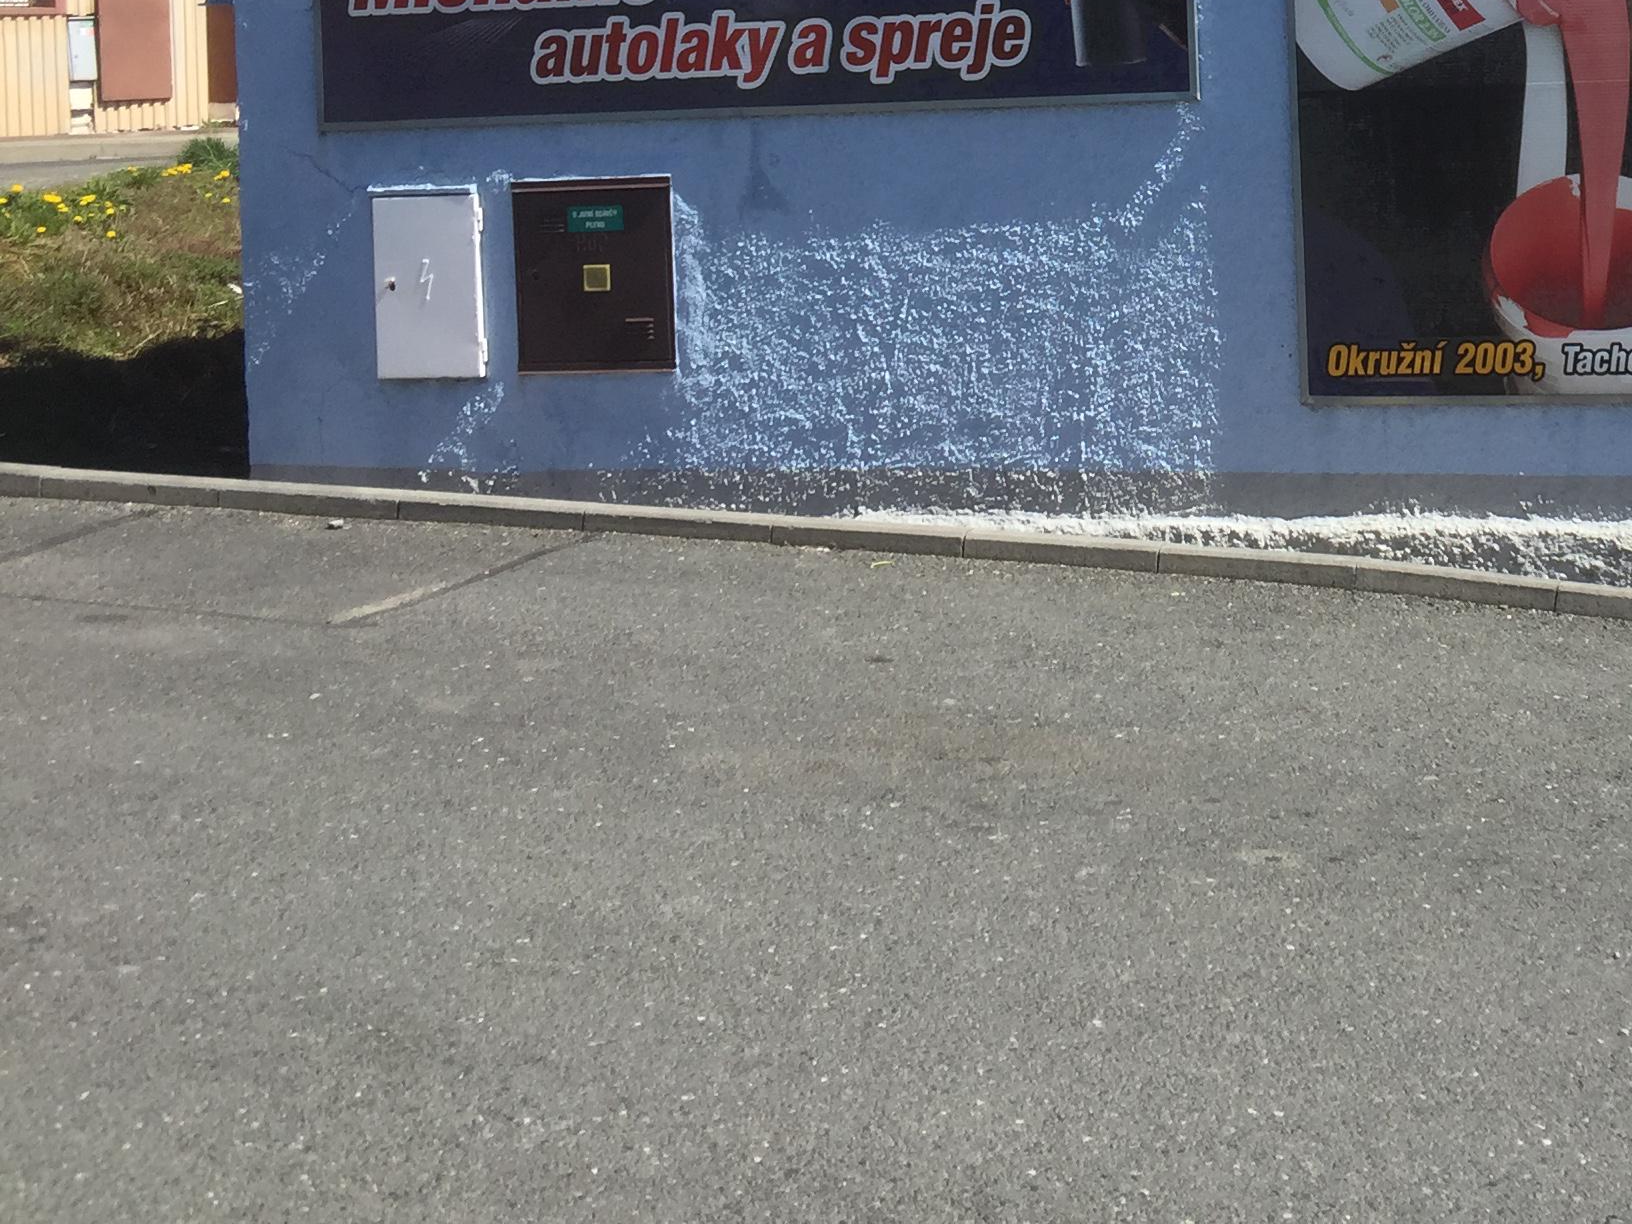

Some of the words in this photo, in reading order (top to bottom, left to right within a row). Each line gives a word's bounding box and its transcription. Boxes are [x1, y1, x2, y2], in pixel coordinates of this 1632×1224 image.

[531, 13, 782, 88] autolaky
[789, 21, 831, 72] a
[1326, 338, 1447, 379] Okružní
[1455, 339, 1546, 381] 2003,
